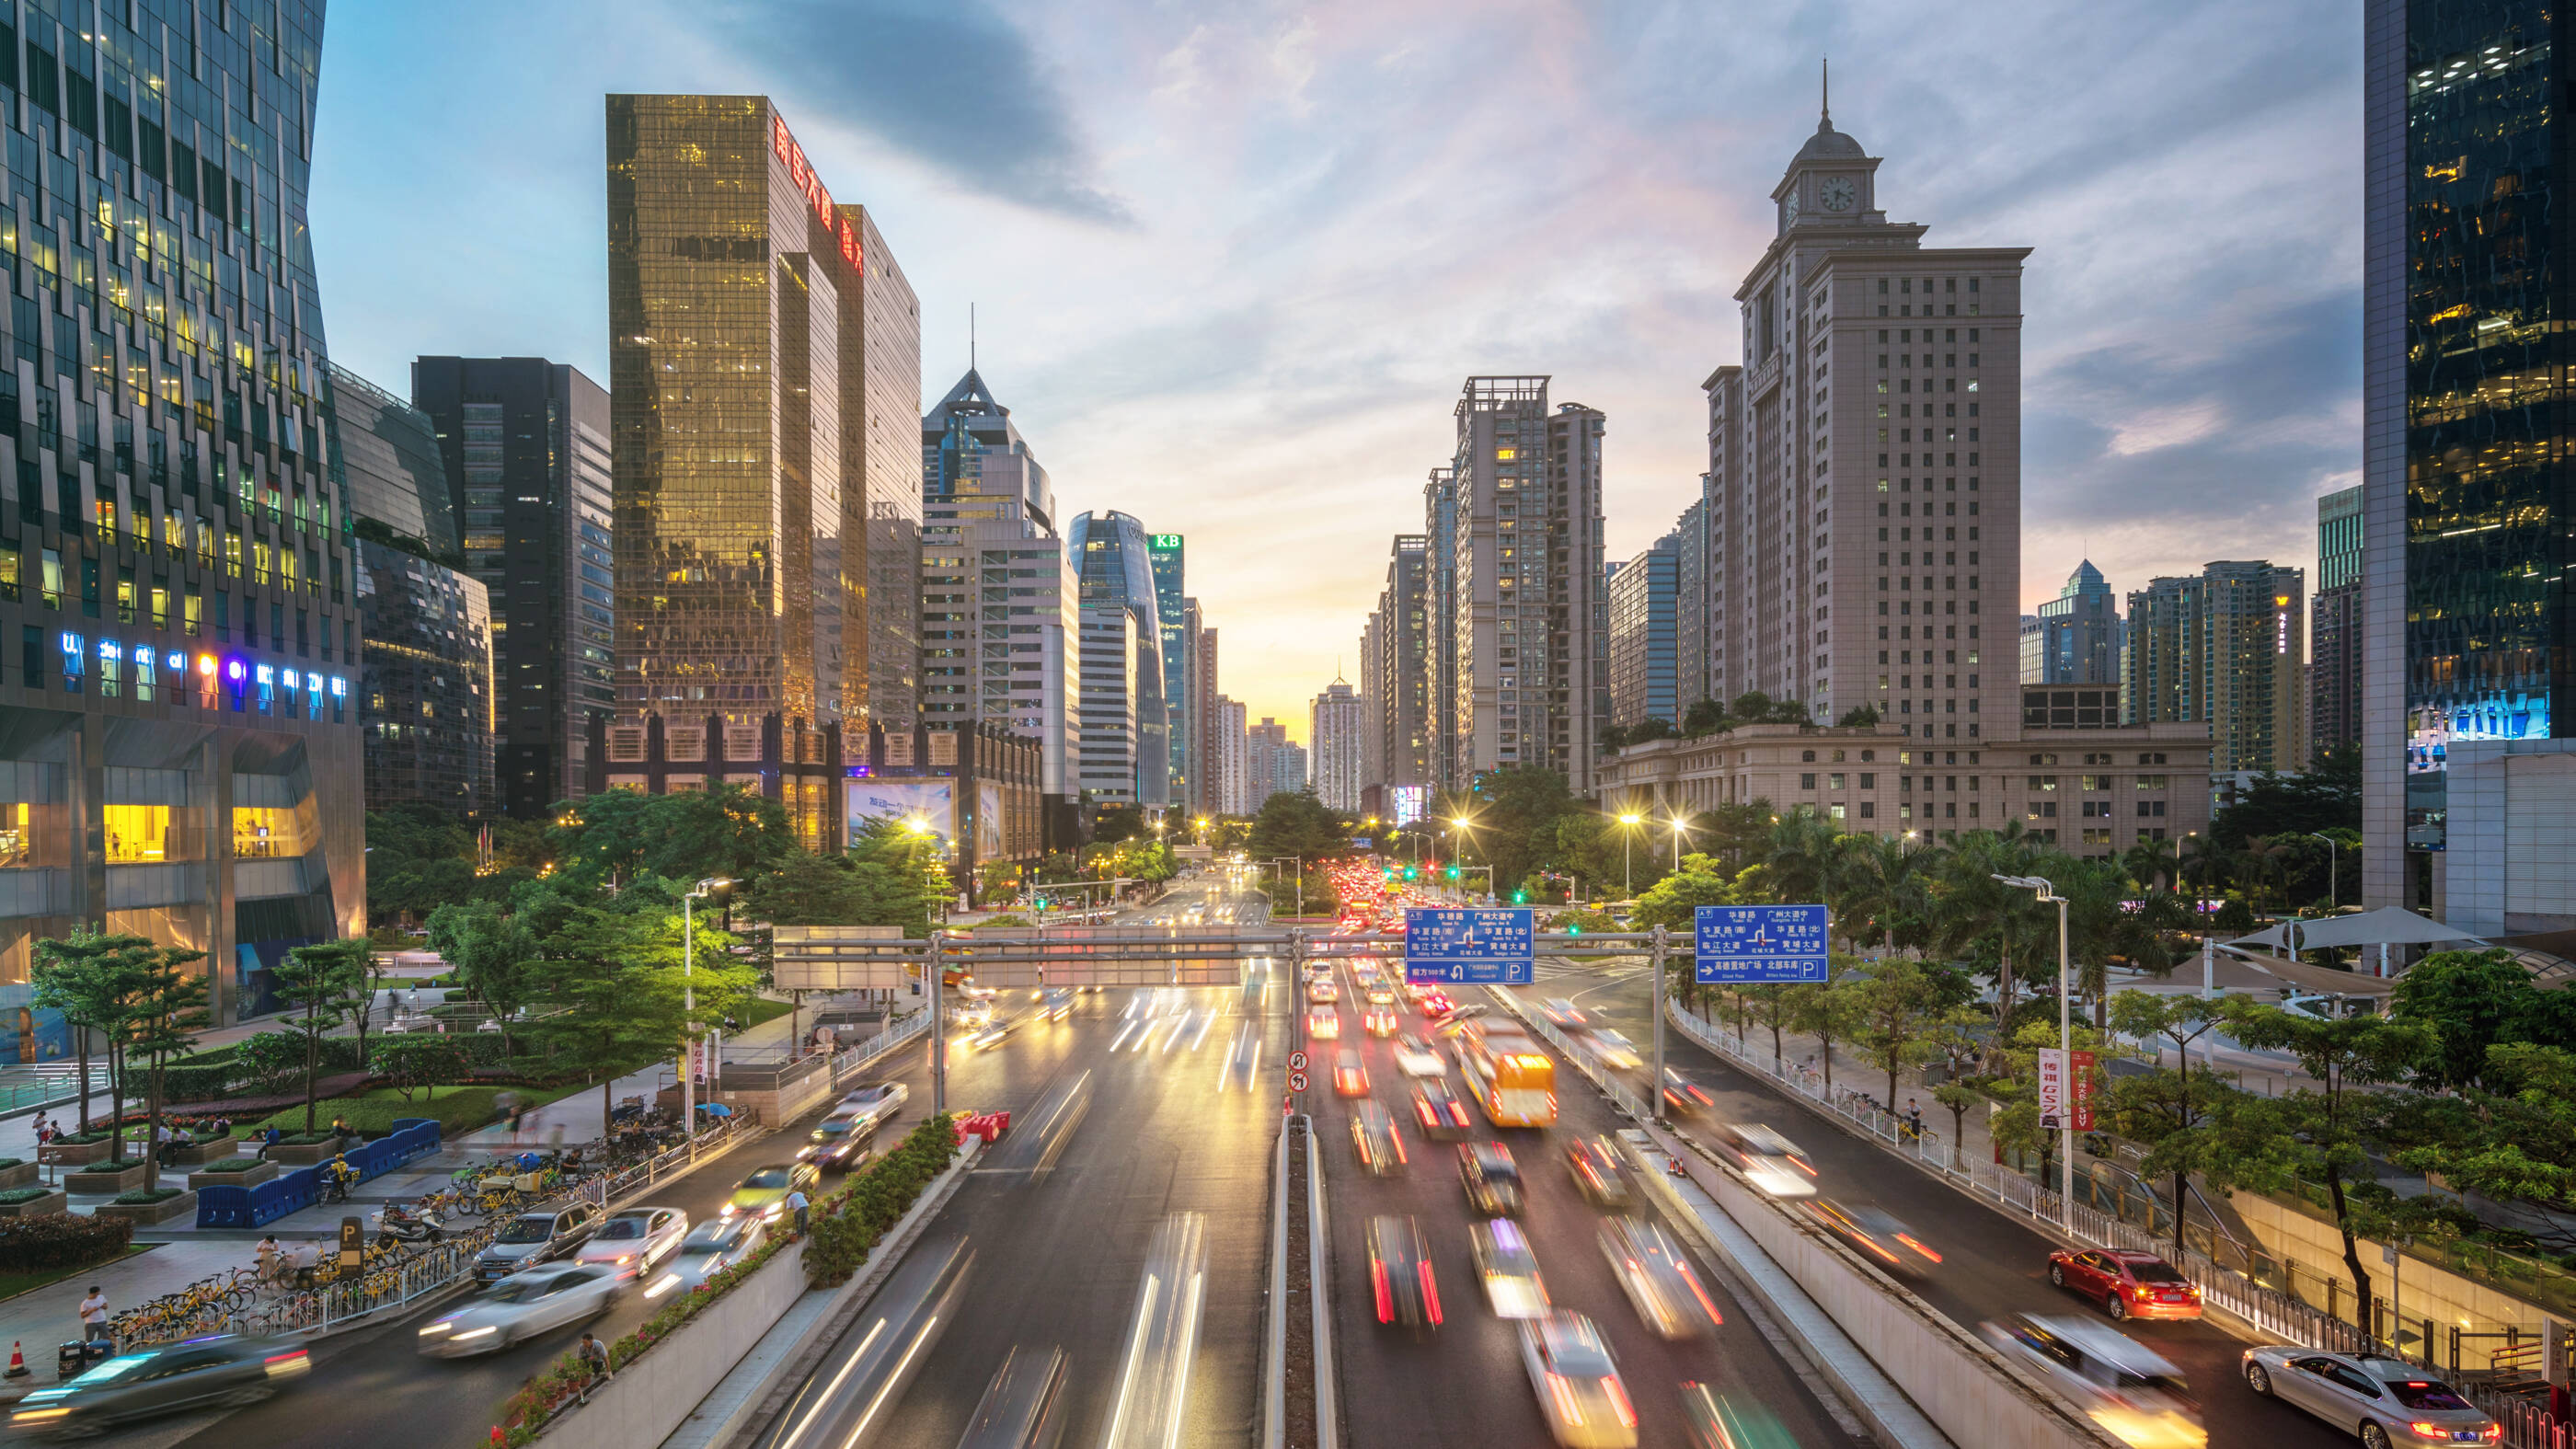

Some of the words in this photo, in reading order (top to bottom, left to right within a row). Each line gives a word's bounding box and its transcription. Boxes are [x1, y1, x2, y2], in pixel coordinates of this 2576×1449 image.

[1474, 912, 1514, 920] 广州大道中
[1767, 910, 1809, 919] 广州大道中
[1411, 942, 1449, 951] 临江大道
[1489, 942, 1527, 950] 黄埔大道
[1702, 941, 1741, 949] 临江大道
[1782, 940, 1821, 949] 黄埔大道
[1715, 960, 1762, 971] 高德置地广场
[1767, 960, 1798, 970] 北部车库
[1803, 961, 1814, 977] P
[1510, 964, 1521, 980] P
[343, 1225, 356, 1242] P
